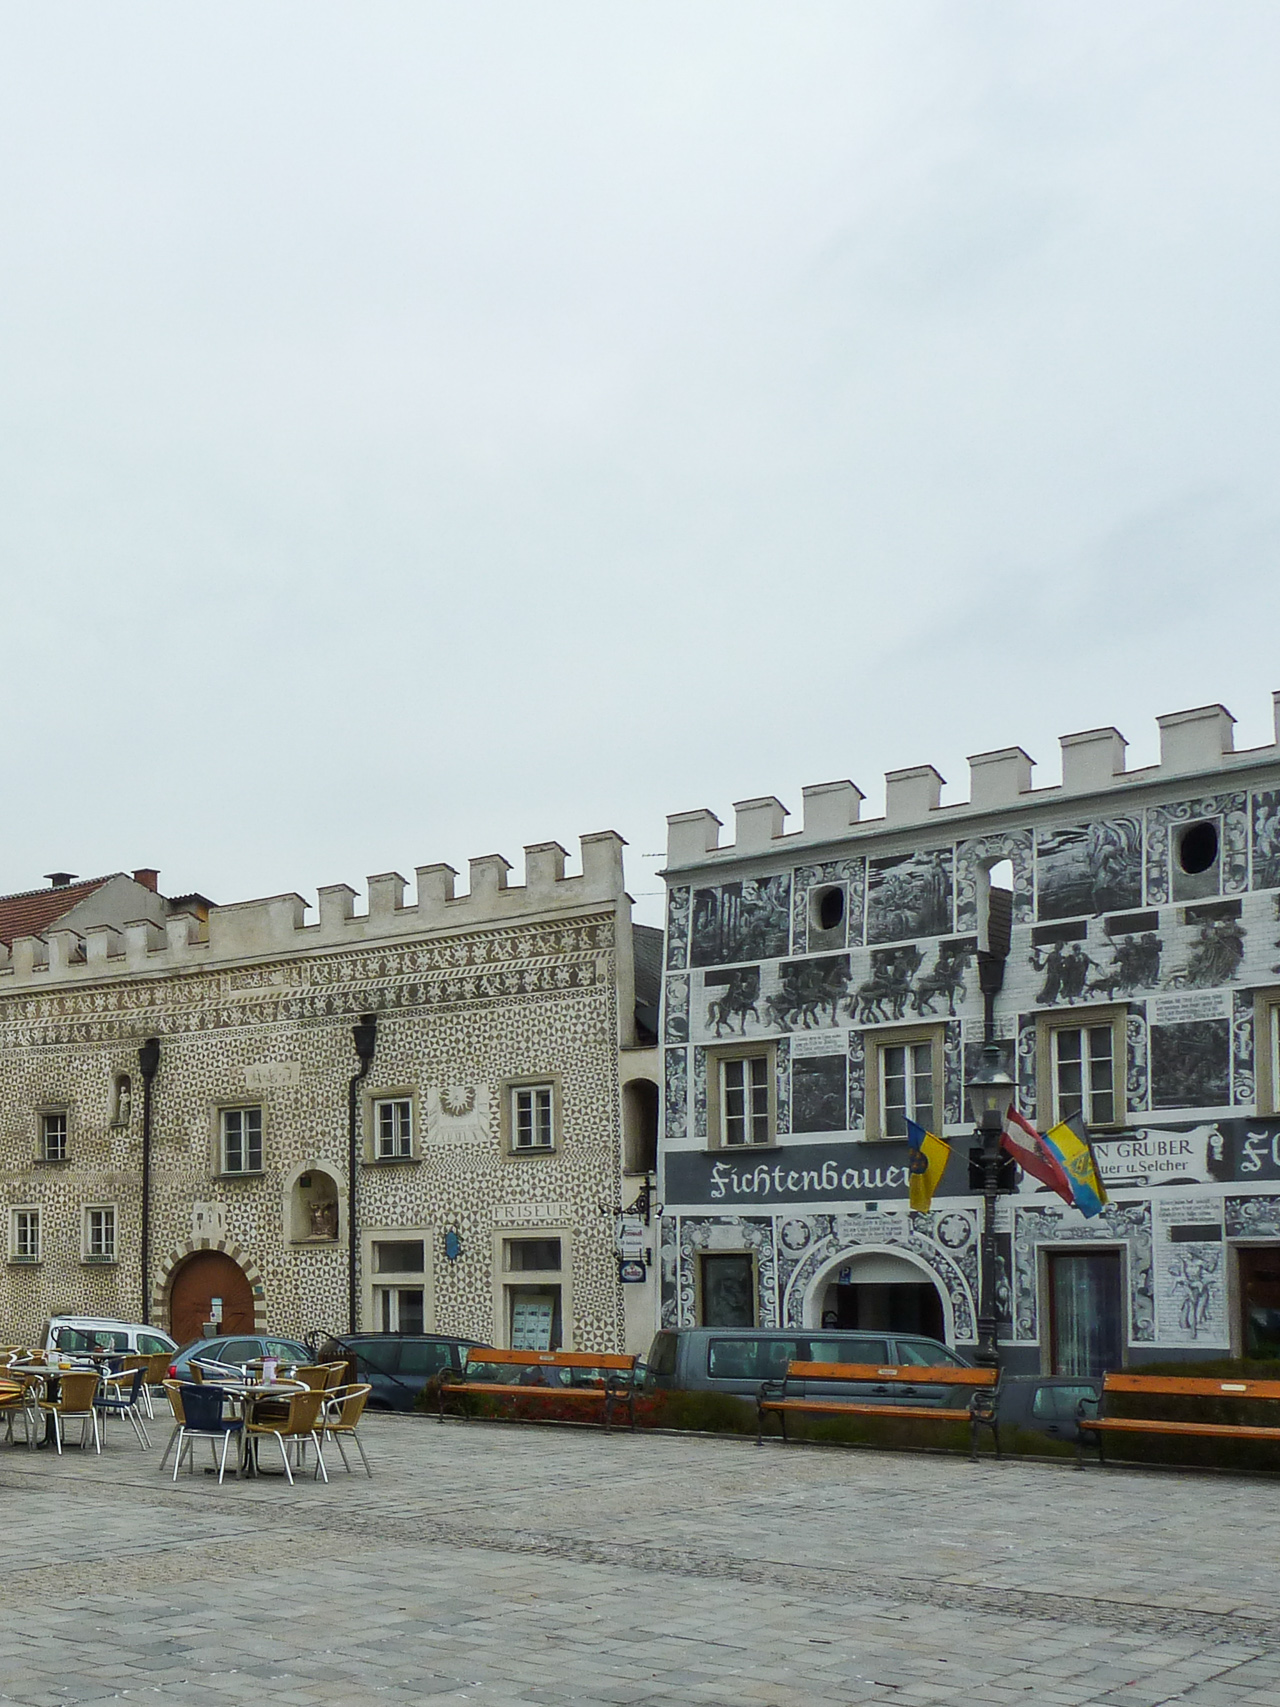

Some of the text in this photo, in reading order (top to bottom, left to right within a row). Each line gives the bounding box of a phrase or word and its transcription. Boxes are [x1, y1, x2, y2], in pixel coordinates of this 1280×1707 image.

[1116, 1139, 1194, 1158] GRUBER
[1099, 1164, 1123, 1175] uer
[1138, 1159, 1189, 1172] Selcher
[494, 1203, 570, 1219] FRISEUR
